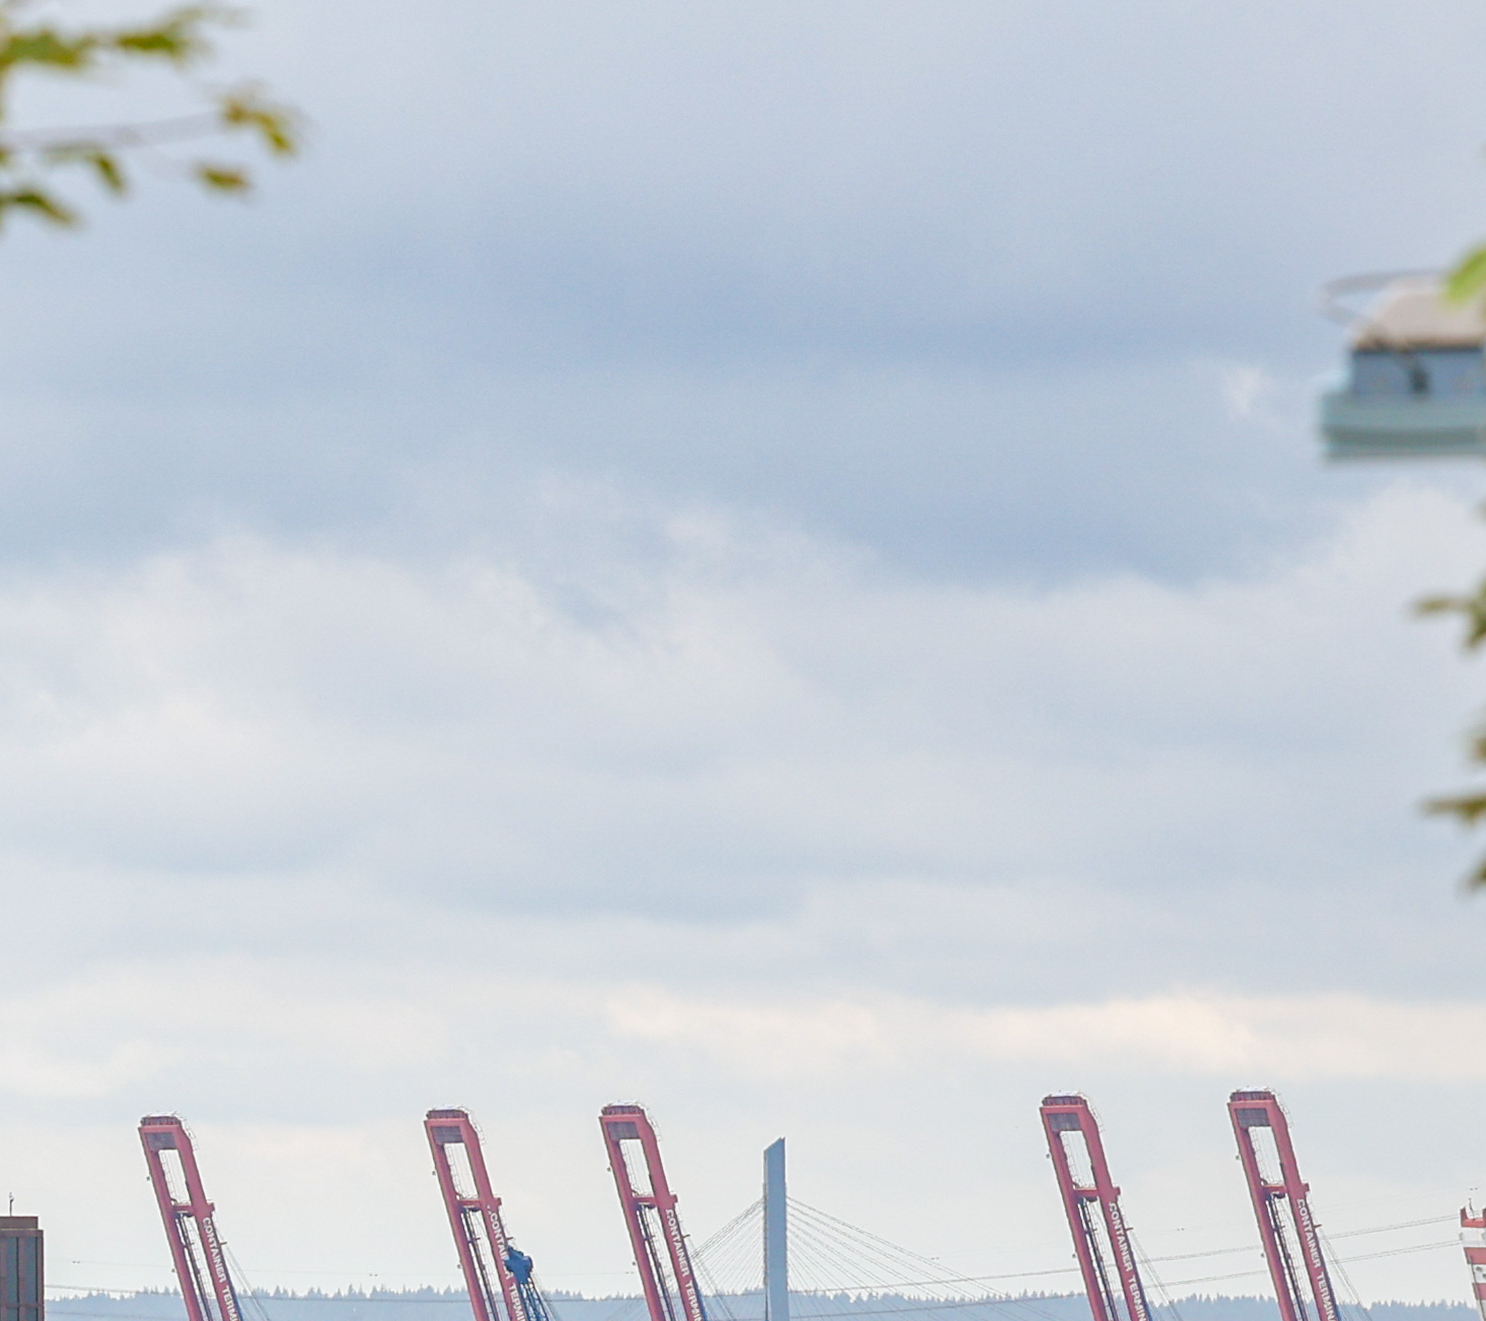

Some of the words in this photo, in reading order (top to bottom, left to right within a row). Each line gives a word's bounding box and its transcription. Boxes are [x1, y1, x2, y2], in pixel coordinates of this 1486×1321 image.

[202, 1217, 227, 1283] CONTAINER
[665, 1208, 689, 1277] CONTAINER
[1108, 1202, 1133, 1272] CONTAINER
[1297, 1198, 1321, 1268] CONTAINER
